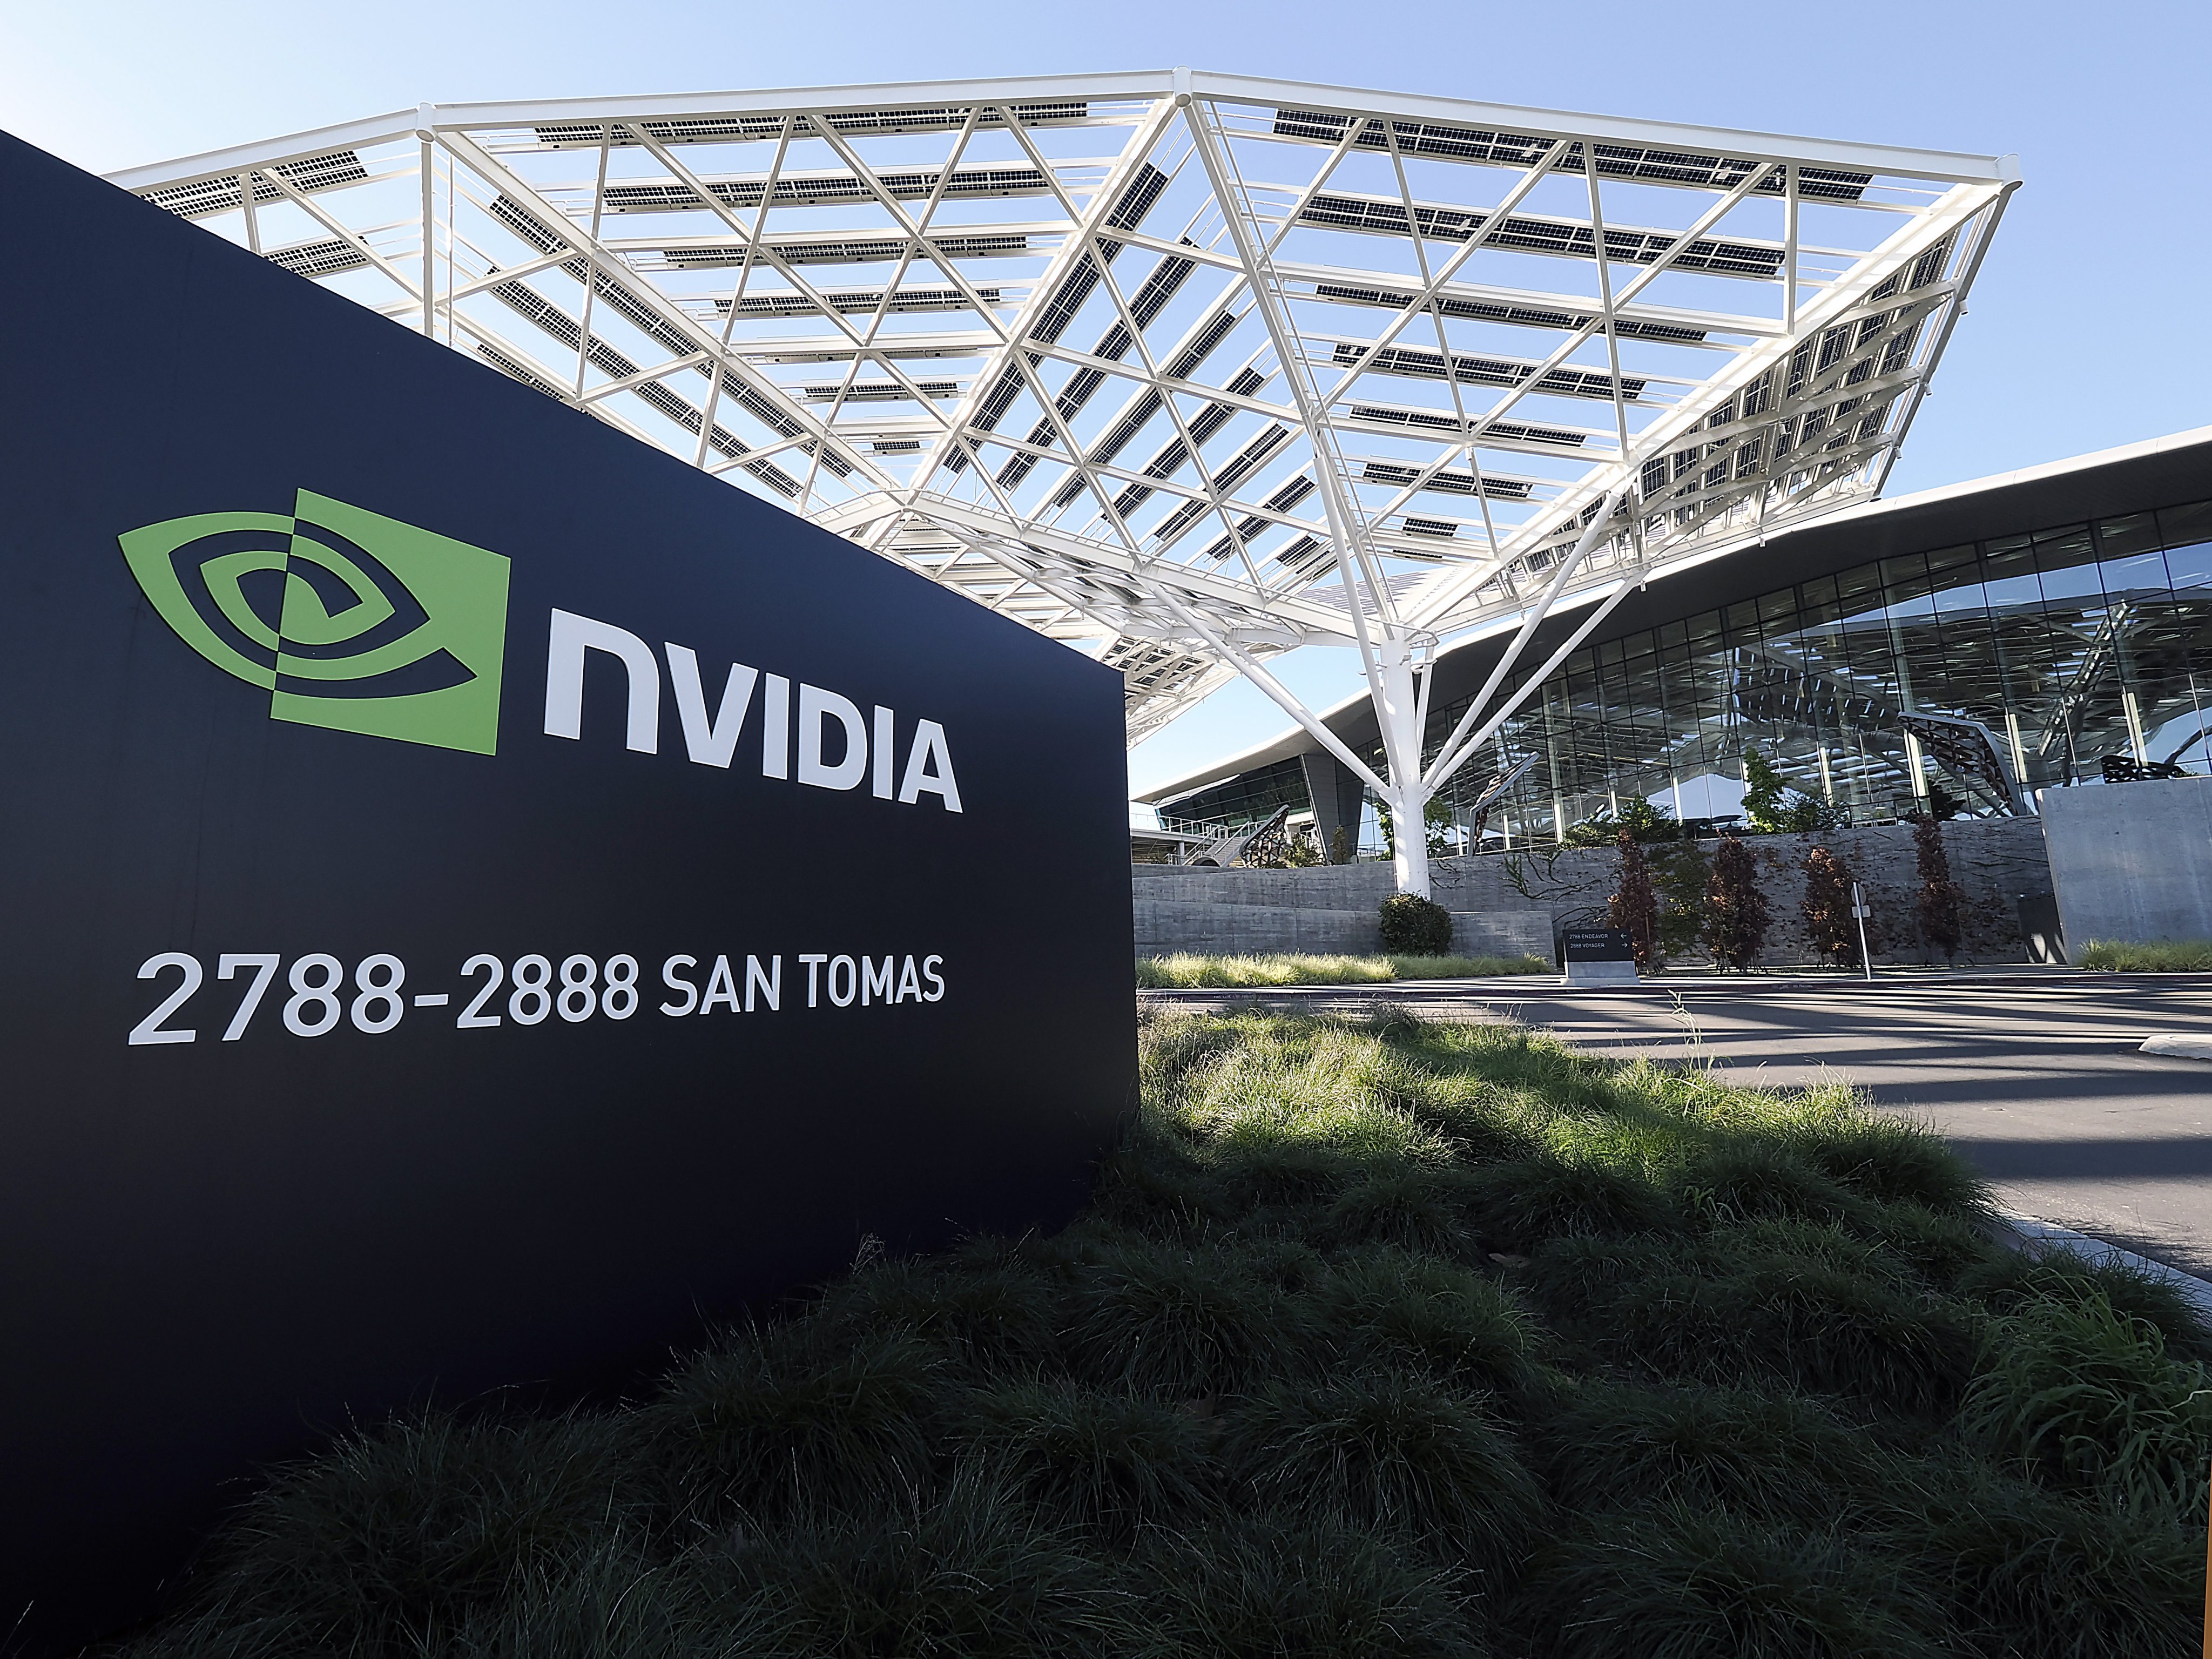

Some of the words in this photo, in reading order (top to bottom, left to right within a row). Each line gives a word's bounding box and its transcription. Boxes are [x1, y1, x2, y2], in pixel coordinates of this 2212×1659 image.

[128, 952, 639, 1046] 2788-2888
[658, 954, 782, 1017] SAN
[798, 953, 945, 1008] TOMAS
